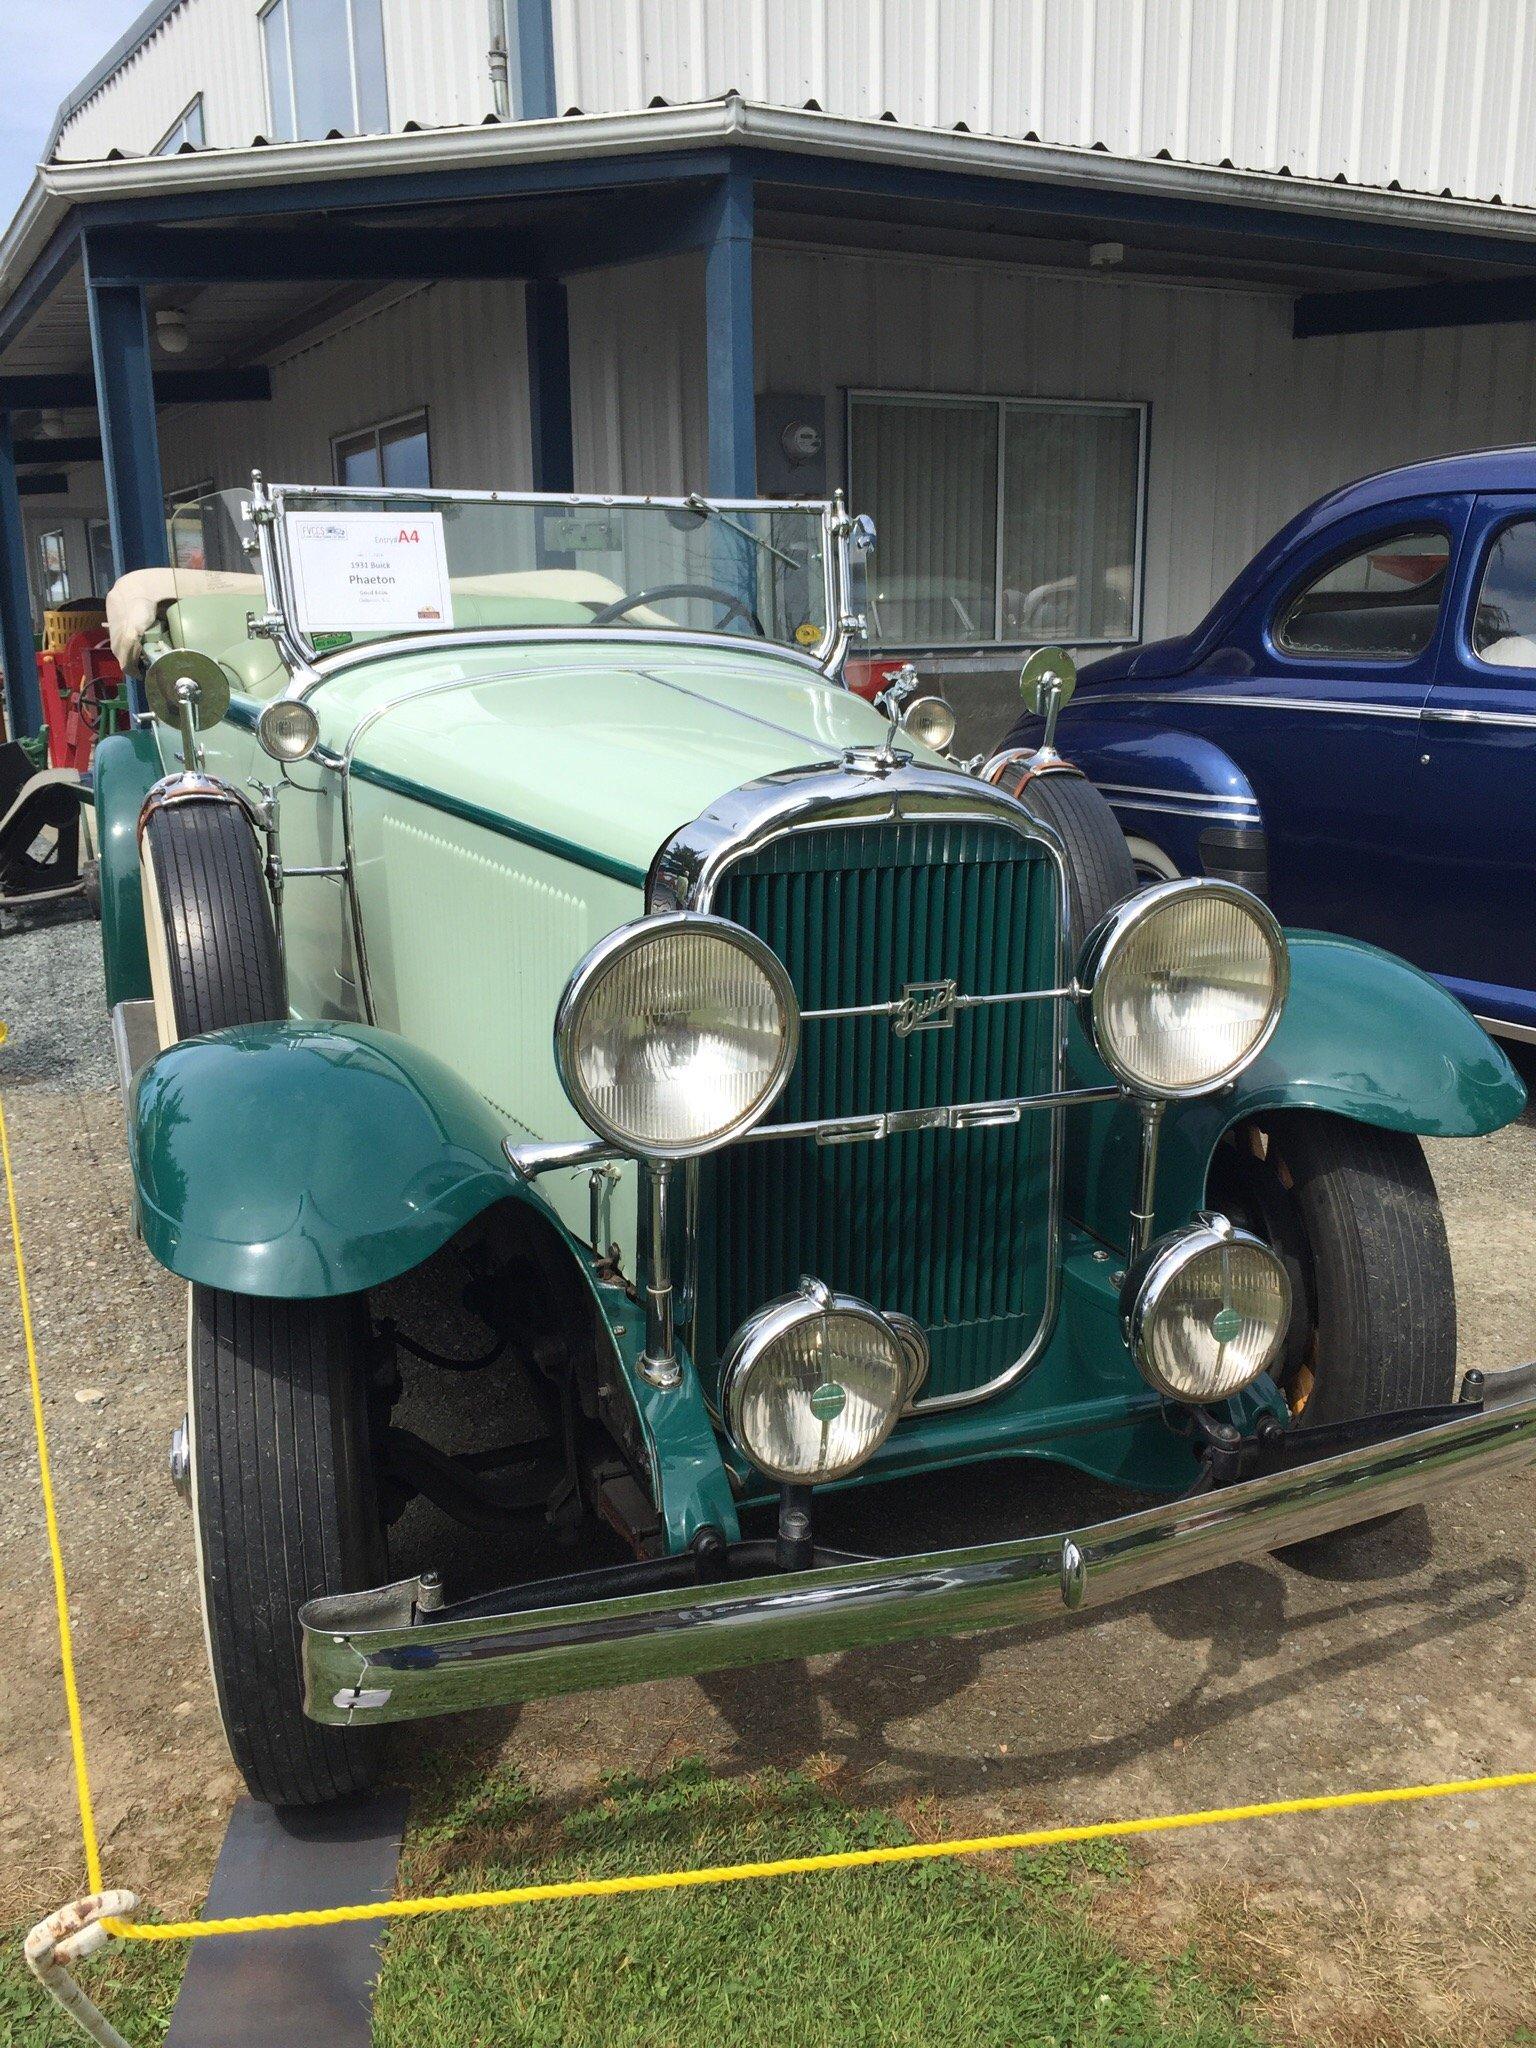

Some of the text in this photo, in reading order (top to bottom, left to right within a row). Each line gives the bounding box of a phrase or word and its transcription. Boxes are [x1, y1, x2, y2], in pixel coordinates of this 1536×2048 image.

[398, 530, 420, 544] A4
[370, 561, 391, 569] Buick
[349, 575, 396, 584] Phaeton
[895, 979, 956, 1037] Buick
